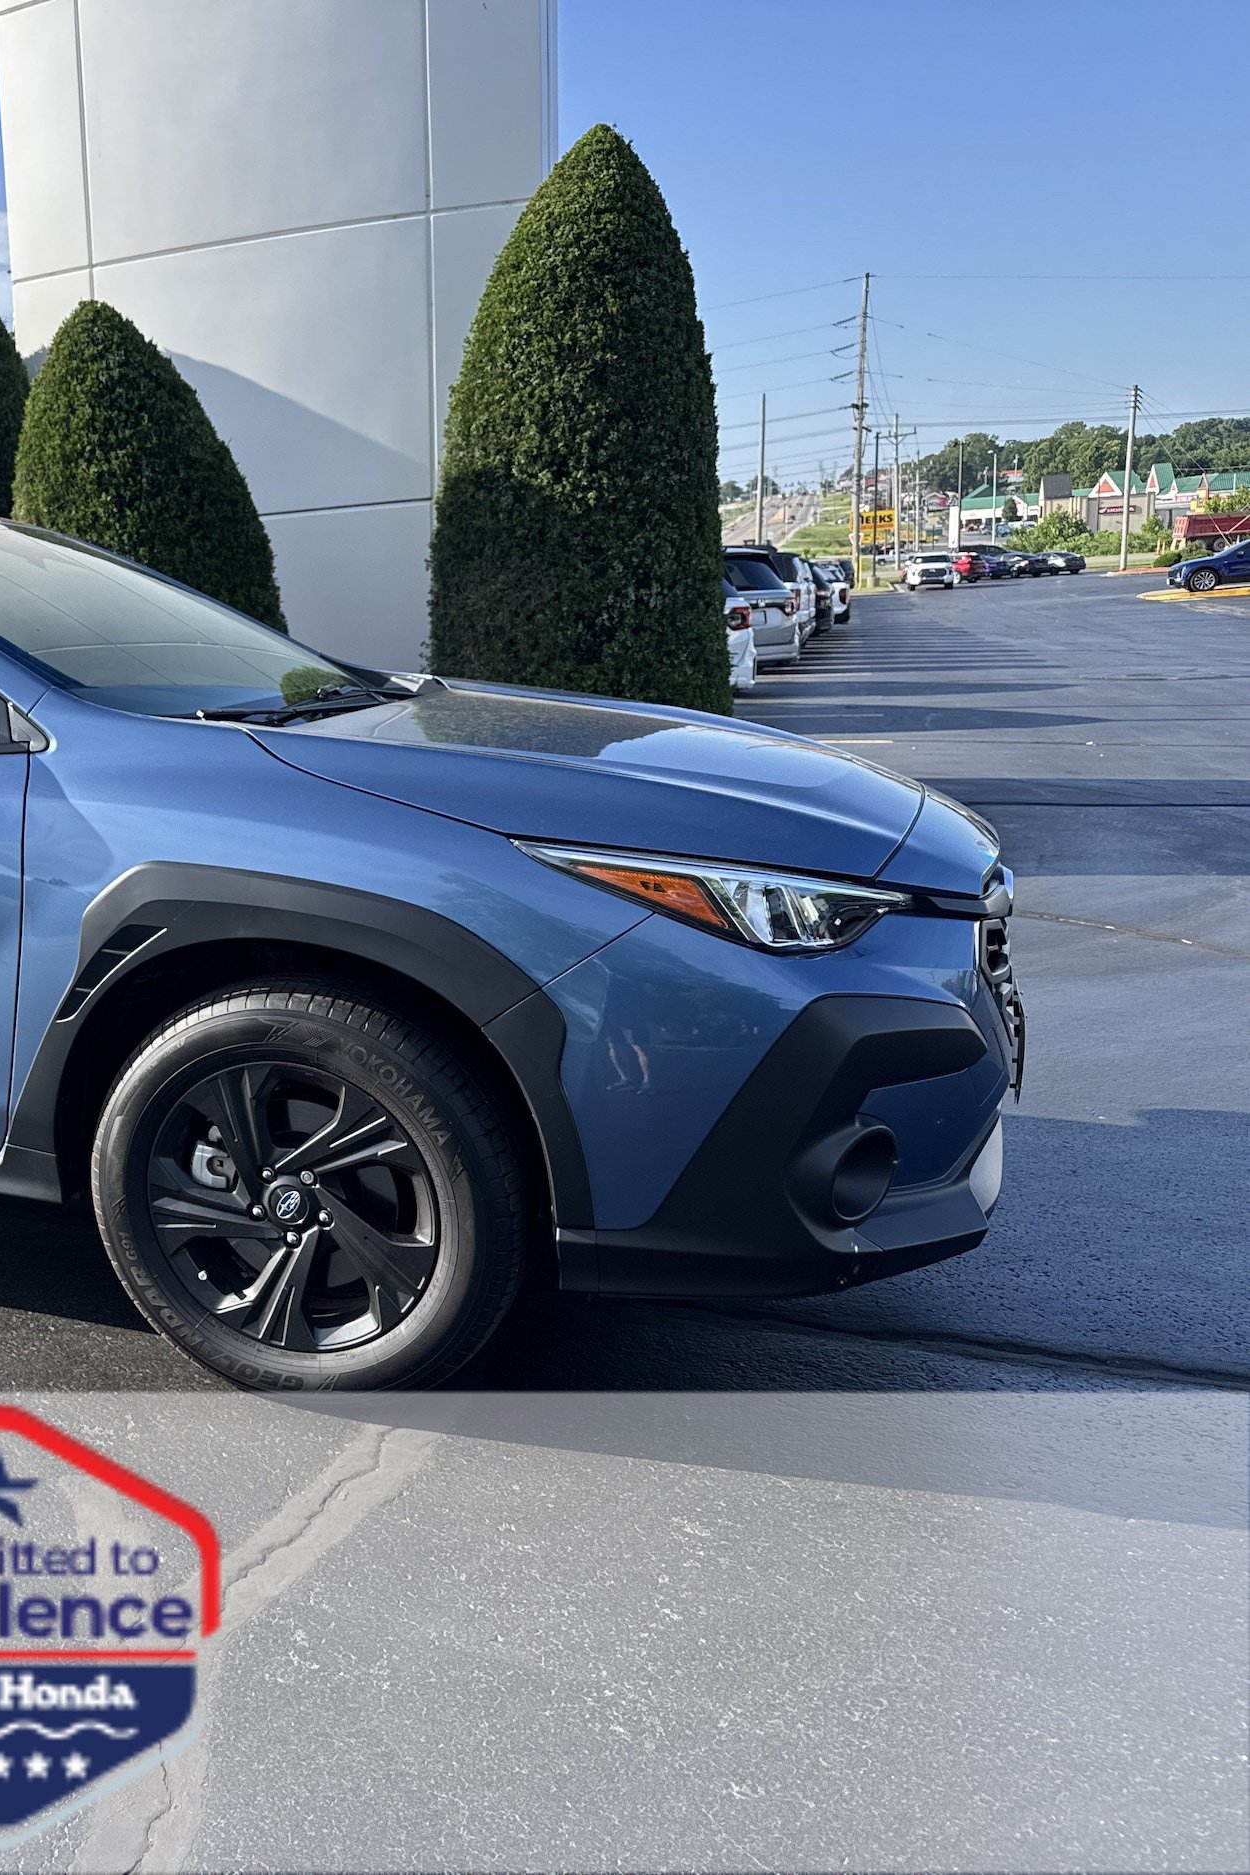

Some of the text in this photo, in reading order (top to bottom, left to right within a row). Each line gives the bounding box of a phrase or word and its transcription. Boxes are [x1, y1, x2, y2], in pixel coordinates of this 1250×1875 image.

[336, 1037, 452, 1147] YOKOHAMA
[118, 1231, 138, 1262] G91
[130, 1265, 304, 1391] GEOLANDAR
